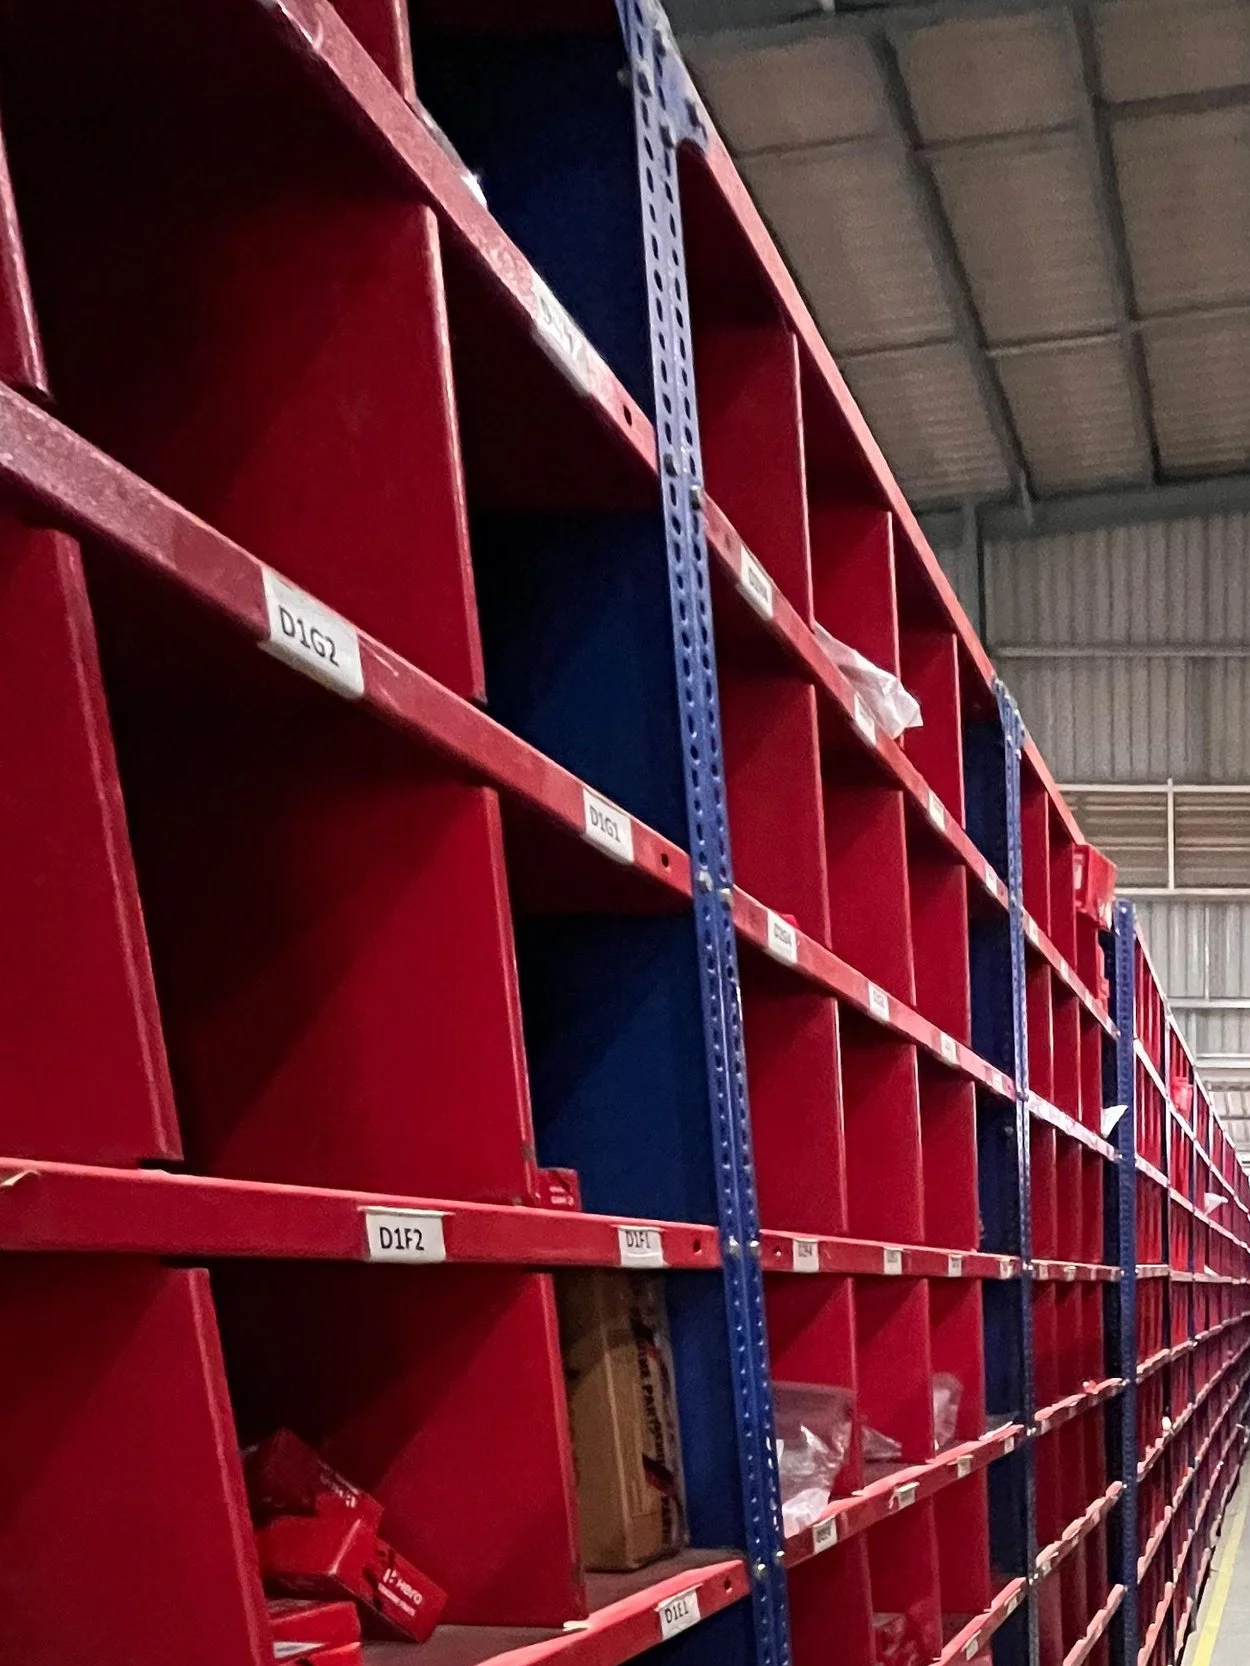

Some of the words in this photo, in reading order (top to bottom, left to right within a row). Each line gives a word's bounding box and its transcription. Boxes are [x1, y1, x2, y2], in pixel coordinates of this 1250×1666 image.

[279, 603, 340, 668] D1G2
[590, 805, 620, 843] D1G1
[380, 1225, 425, 1252] D1F2
[626, 1231, 651, 1250] D1F1
[664, 1600, 690, 1624] D1E1
